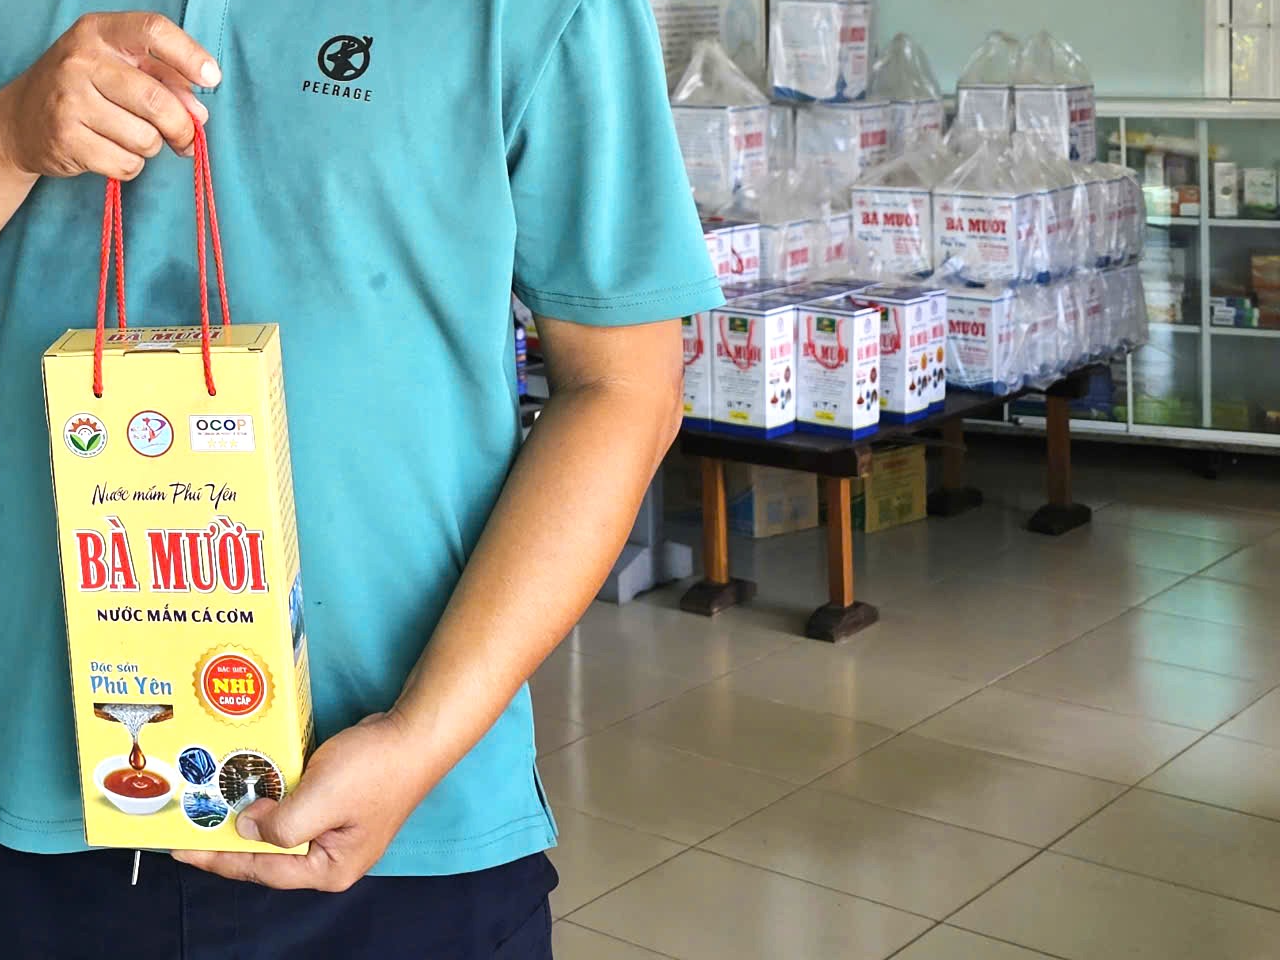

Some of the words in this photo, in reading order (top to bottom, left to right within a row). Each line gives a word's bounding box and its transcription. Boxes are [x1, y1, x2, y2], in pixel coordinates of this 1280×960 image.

[302, 80, 372, 101] PEERAGE
[196, 419, 247, 431] OCOP
[92, 481, 130, 506] Nước
[133, 485, 168, 502] mắm
[169, 481, 202, 504] Phú
[205, 482, 237, 510] Yên
[75, 517, 139, 591] BÀ
[147, 517, 267, 592] MƯỜI
[97, 606, 143, 622] NƯỚC
[147, 604, 187, 622] MẮM
[192, 607, 213, 623] CÁ
[216, 608, 254, 624] CƠM
[90, 661, 113, 675] Đặc
[90, 675, 128, 695] Phú
[134, 676, 172, 696] Yên
[212, 673, 256, 694] NHỈ
[219, 696, 235, 705] CAO
[236, 695, 252, 706] CẤP
